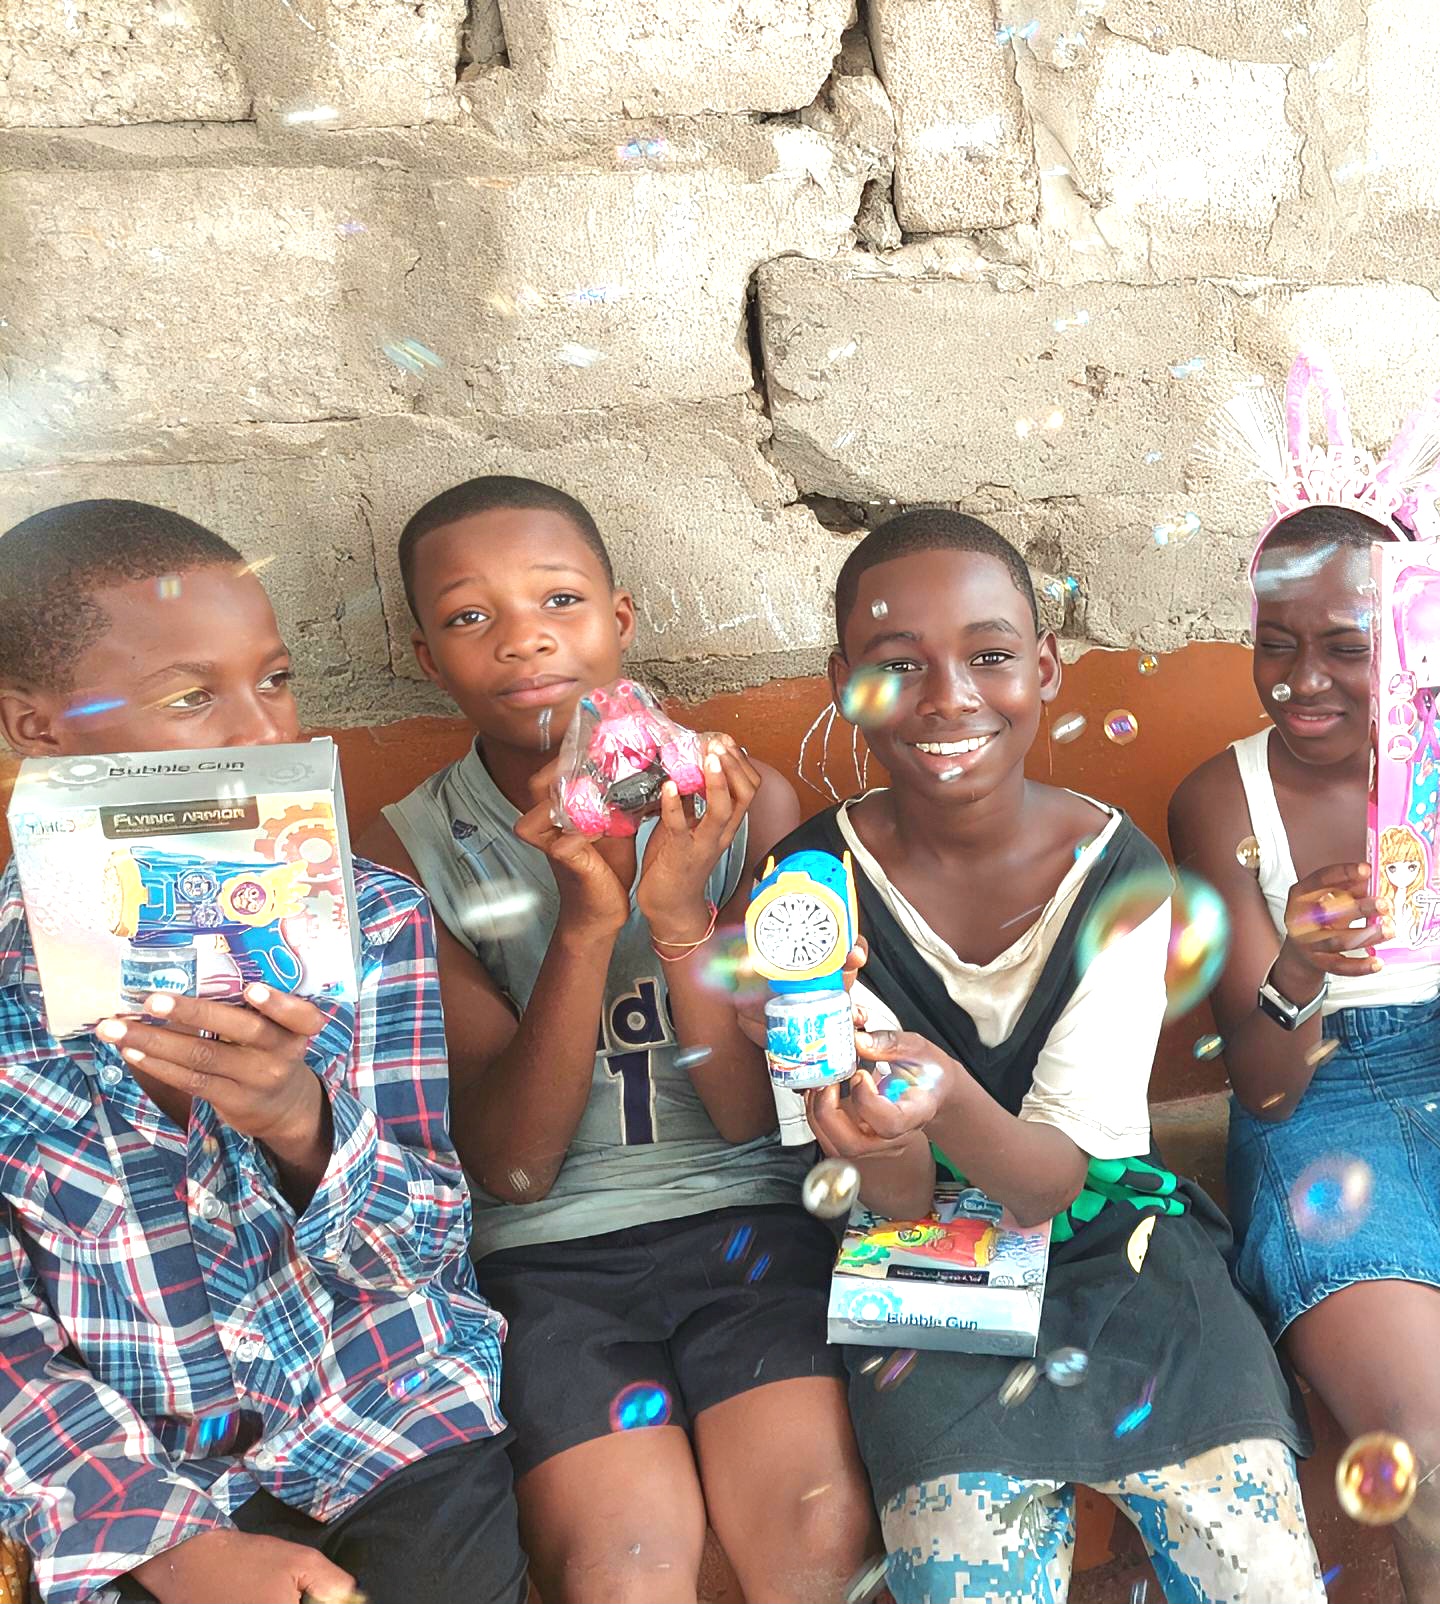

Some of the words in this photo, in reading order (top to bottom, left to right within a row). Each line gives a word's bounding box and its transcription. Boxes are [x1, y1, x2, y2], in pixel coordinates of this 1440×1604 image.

[108, 763, 190, 777] Bubble
[197, 761, 245, 771] Gun
[113, 812, 175, 828] FLYING
[182, 808, 245, 824] ARMOR
[887, 1312, 942, 1329] Bubble
[945, 1316, 978, 1331] Gun
